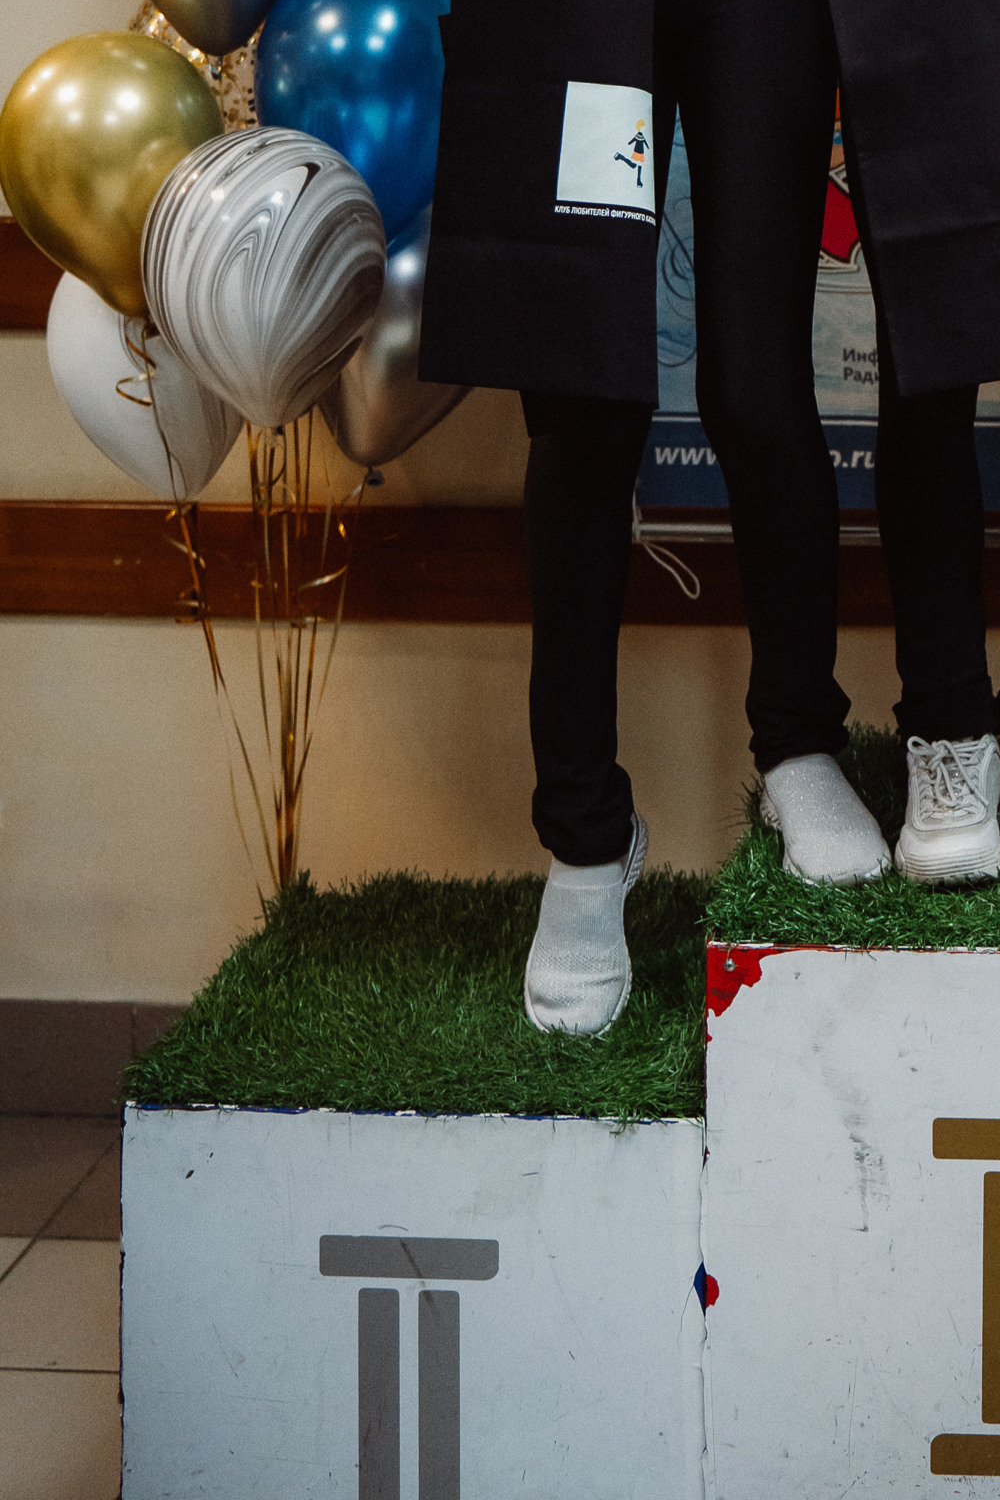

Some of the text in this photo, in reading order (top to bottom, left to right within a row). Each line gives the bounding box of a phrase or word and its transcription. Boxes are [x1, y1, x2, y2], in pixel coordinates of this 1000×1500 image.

[554, 205, 571, 215] КЛУБ
[571, 205, 610, 217] ЛЮБИТЕЛЕЙ
[610, 209, 645, 222] ФИГУРНОГО
